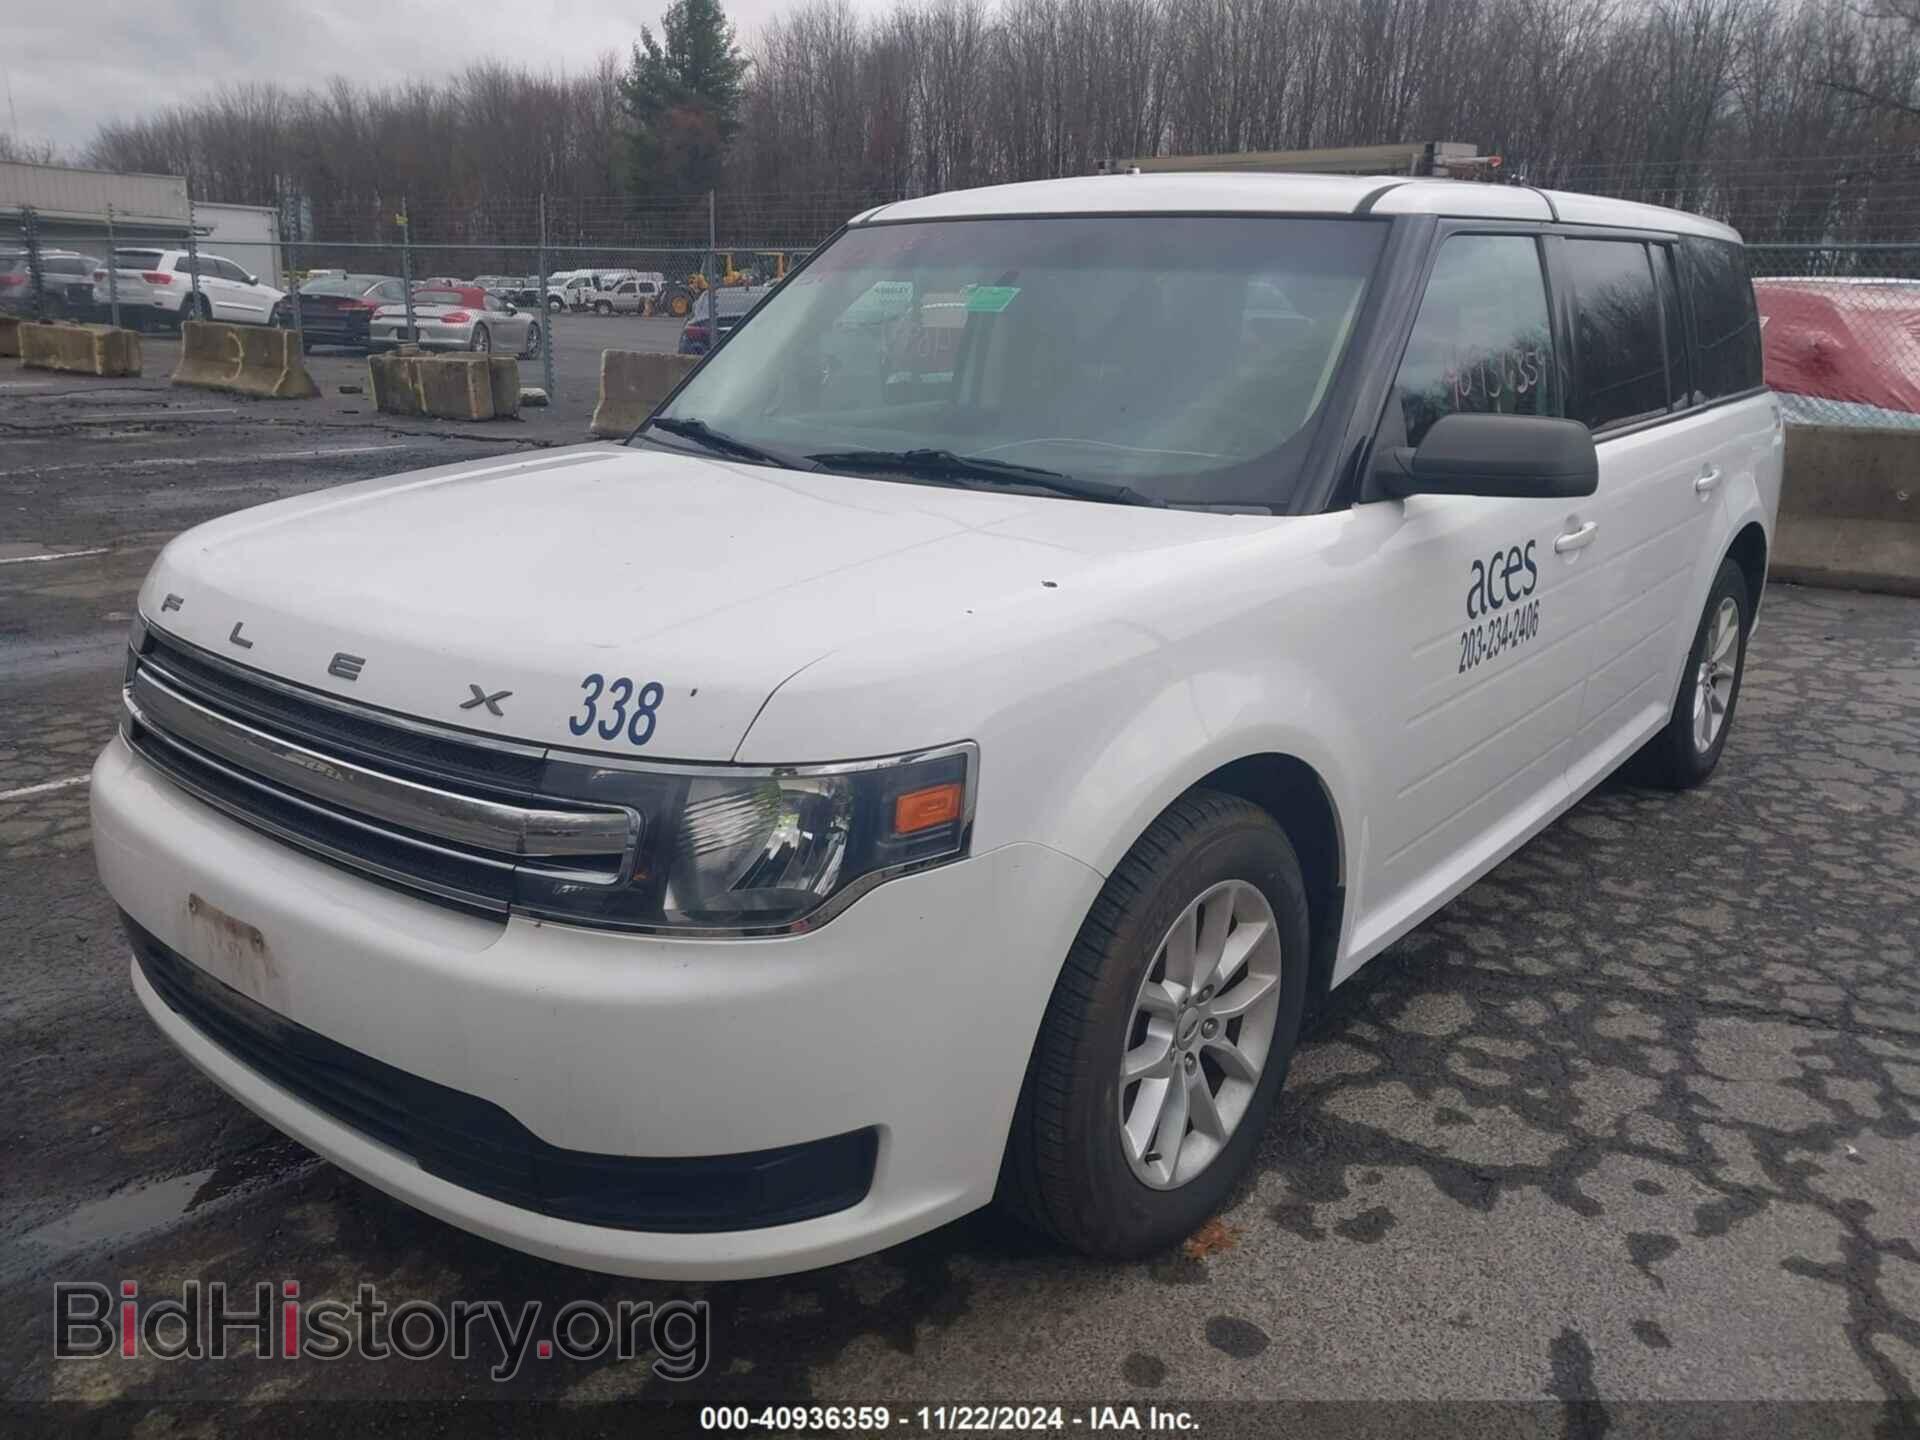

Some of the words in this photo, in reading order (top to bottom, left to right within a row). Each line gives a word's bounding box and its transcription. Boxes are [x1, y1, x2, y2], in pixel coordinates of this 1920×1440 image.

[1467, 540, 1537, 619] aces
[161, 593, 513, 716] FLEX
[1458, 599, 1540, 674] 203-234-2406
[569, 673, 664, 746] 338
